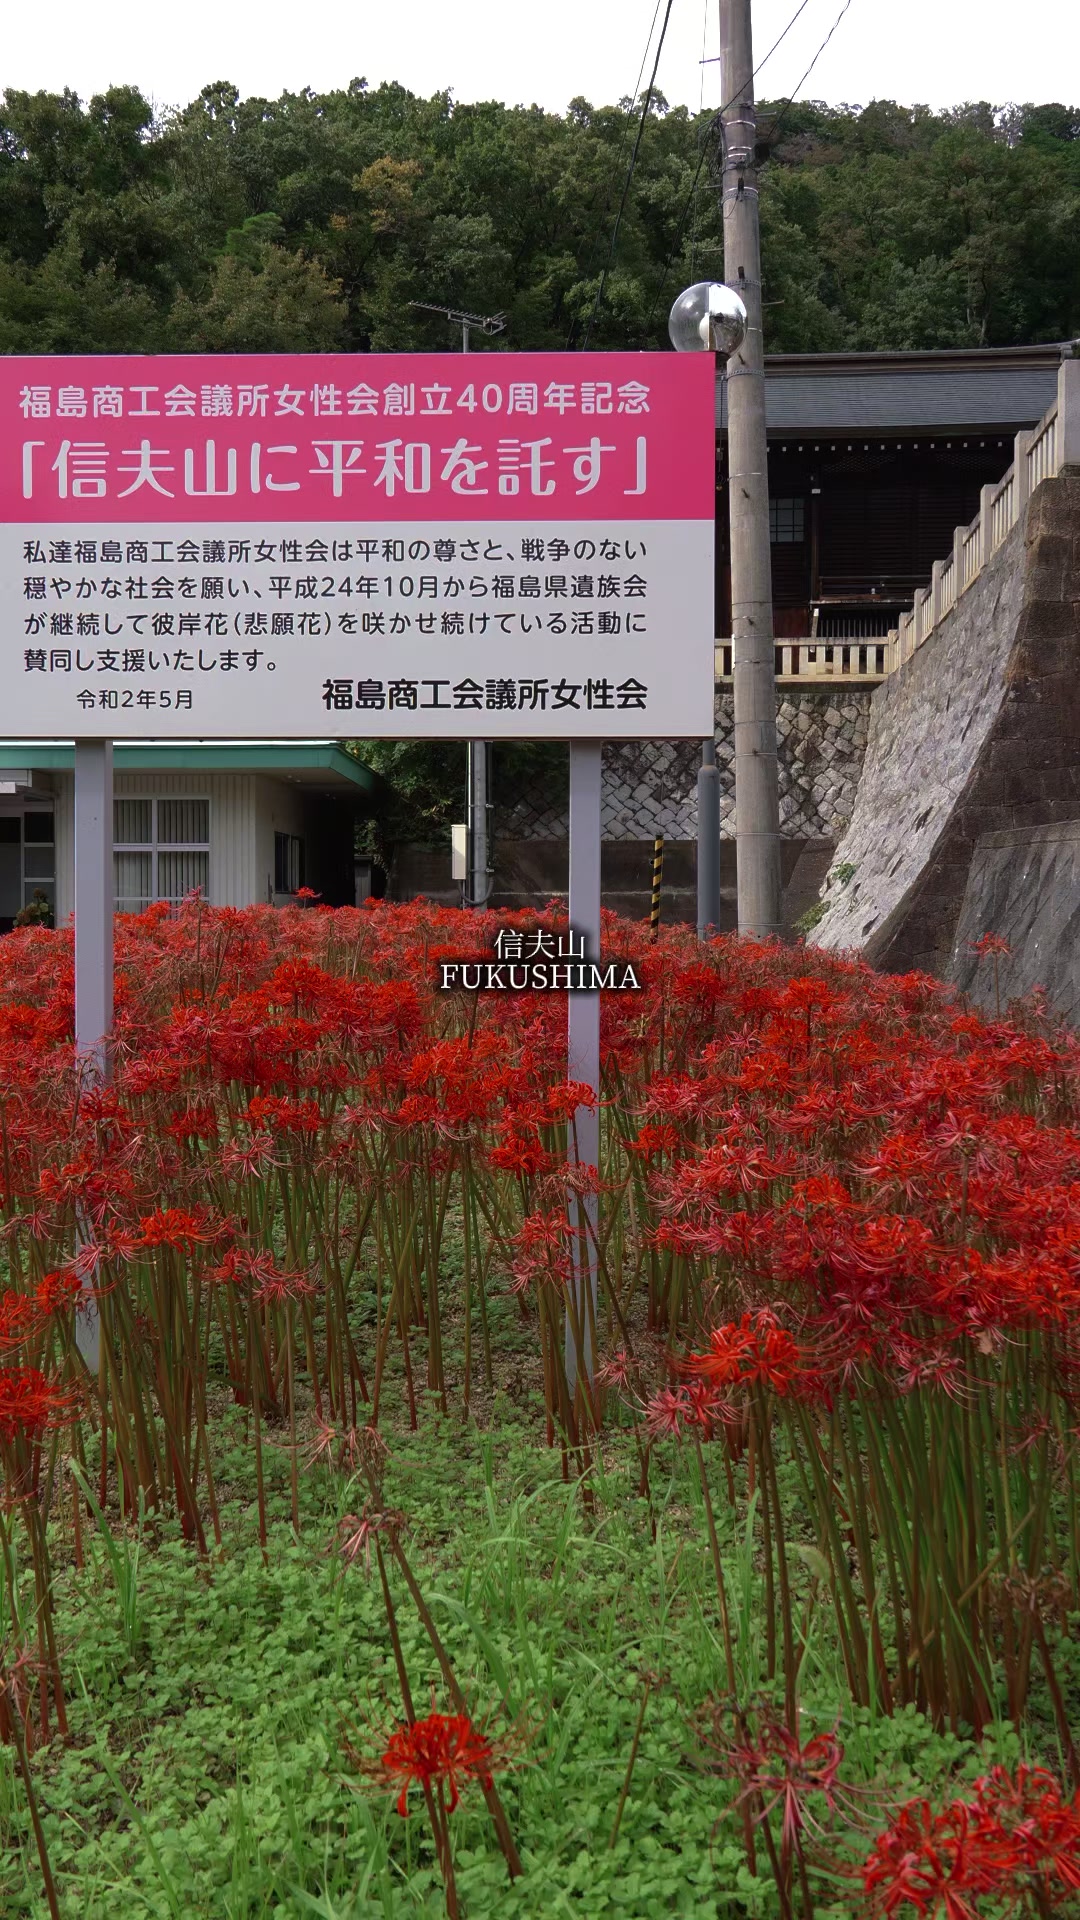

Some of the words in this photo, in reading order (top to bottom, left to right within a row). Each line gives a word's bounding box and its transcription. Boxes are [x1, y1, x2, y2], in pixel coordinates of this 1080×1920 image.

[19, 380, 651, 419] 福島商工会議所女性会創立40周年記念
[22, 436, 647, 499] 「信夫山に平和を託す」
[23, 538, 647, 565] 私達福島商工会議所女性会は平和の尊さと、戦争のない
[23, 574, 648, 600] 穏やかな社会を願い、平成24年10月から福島県遺族会
[24, 610, 647, 637] が継続して彼岸花(悲願花)を咲かせ続けている活動に
[23, 648, 277, 673] 賛同し支援いたします。
[76, 688, 194, 710] 令和2年5月
[322, 677, 649, 711] 福島商工会議所女性会
